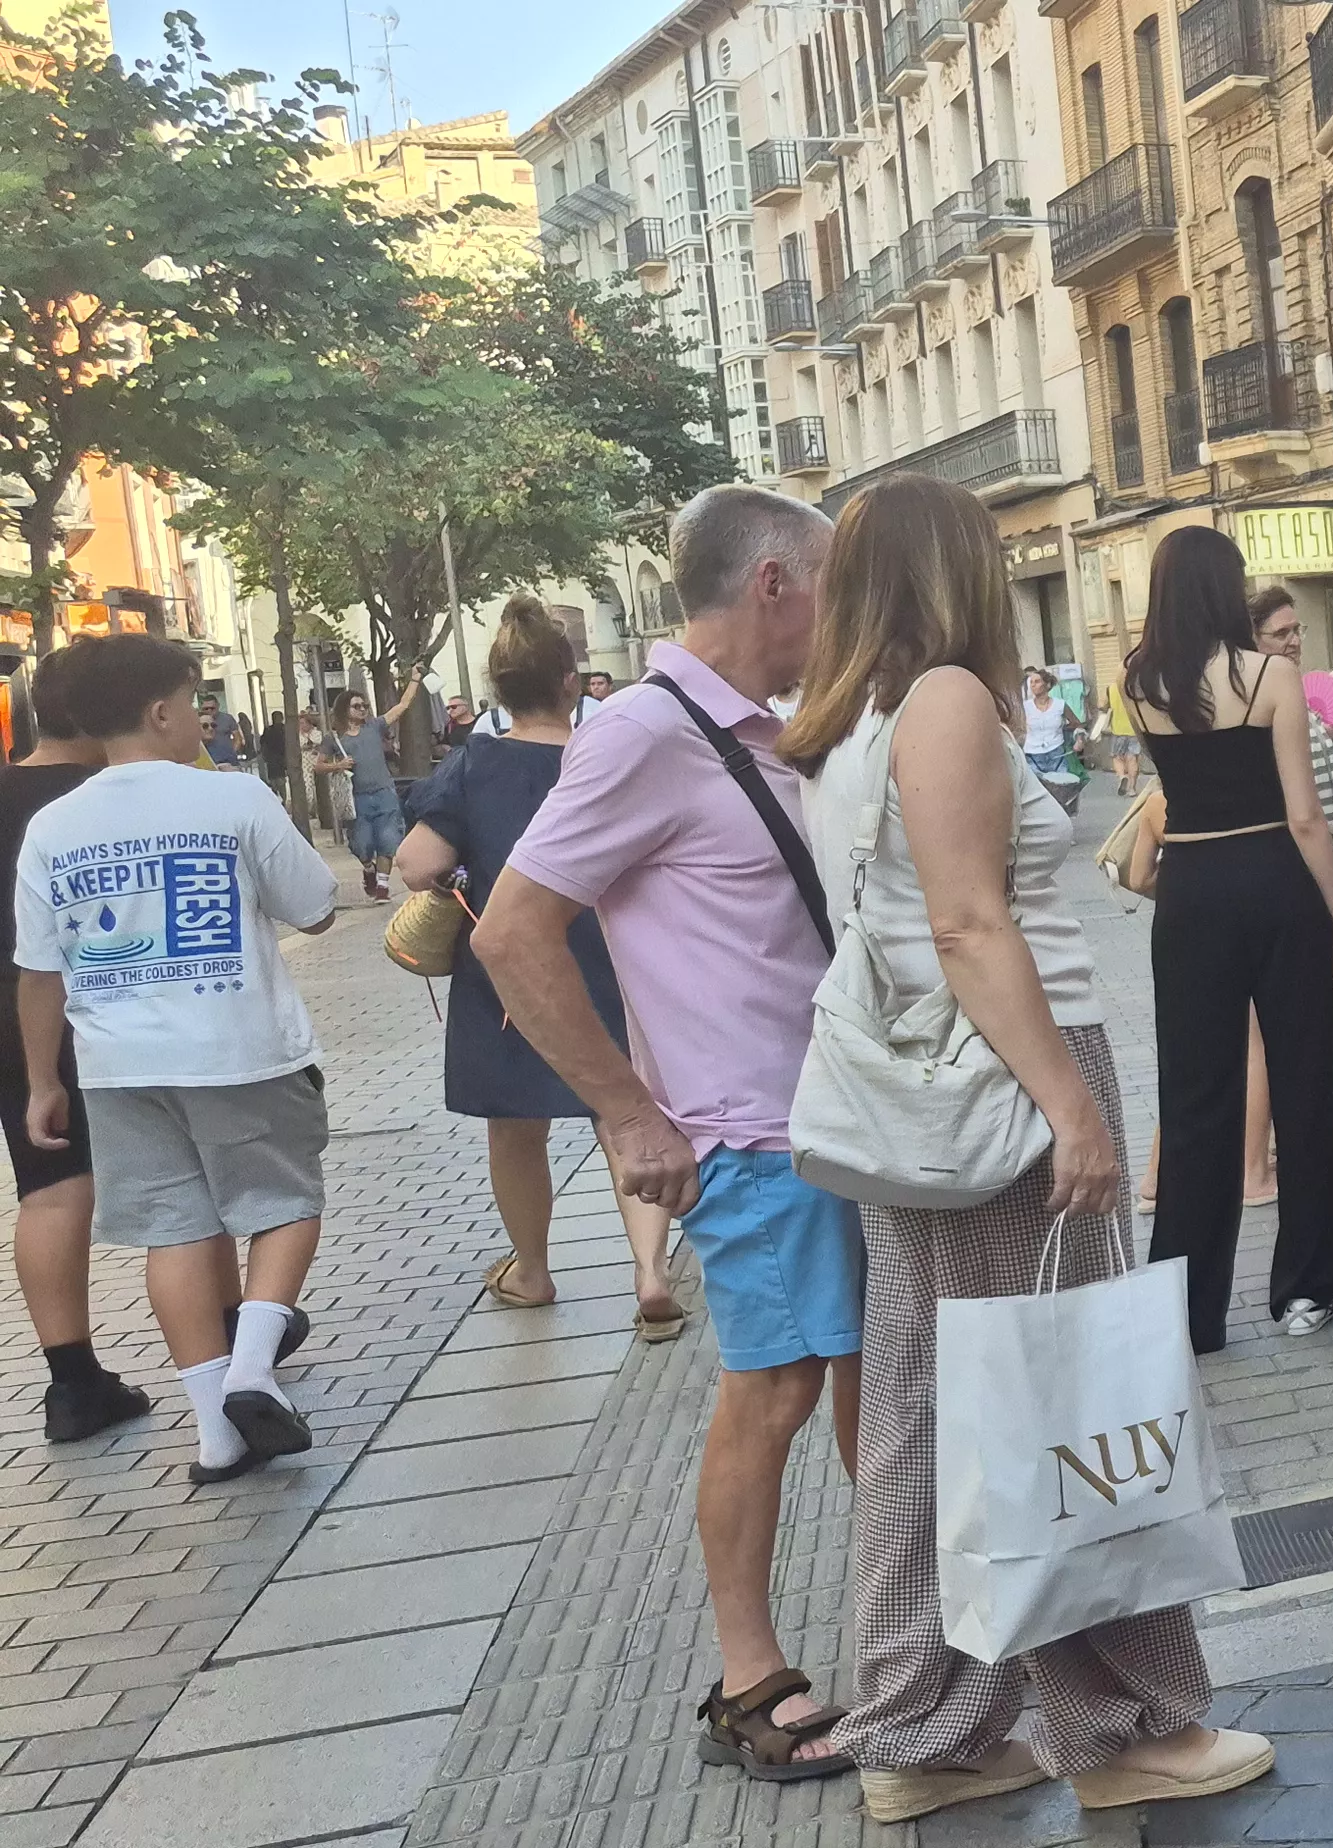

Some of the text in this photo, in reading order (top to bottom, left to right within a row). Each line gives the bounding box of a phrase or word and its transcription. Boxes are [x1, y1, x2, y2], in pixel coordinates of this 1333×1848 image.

[52, 833, 239, 872] ALWAYS STAY HYDRATED
[50, 860, 161, 908] & KEEP IT
[172, 857, 233, 949] FRESH
[121, 969, 143, 984] THE
[145, 962, 200, 980] COLDEST
[203, 959, 244, 975] DROPS
